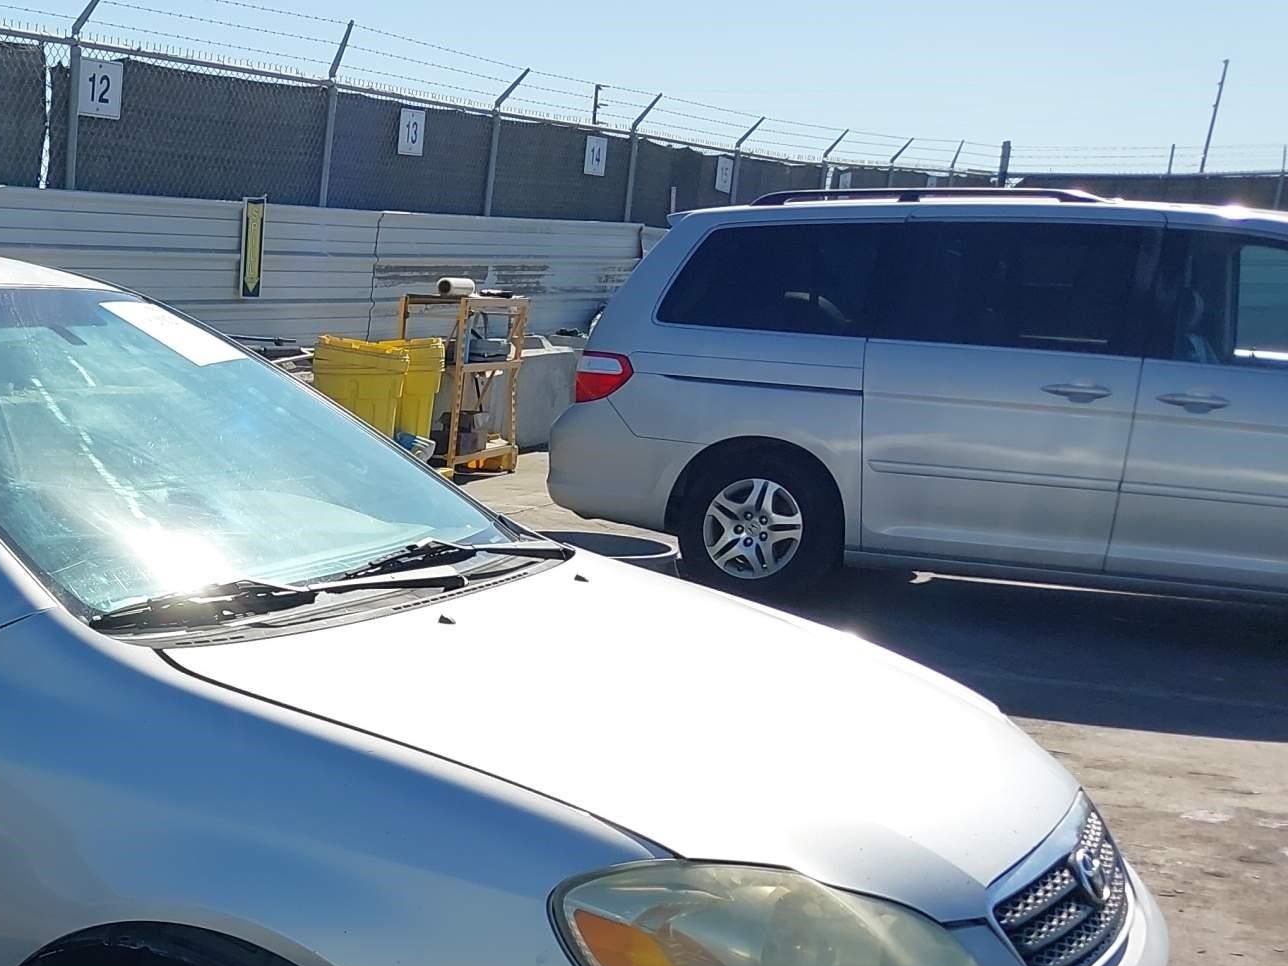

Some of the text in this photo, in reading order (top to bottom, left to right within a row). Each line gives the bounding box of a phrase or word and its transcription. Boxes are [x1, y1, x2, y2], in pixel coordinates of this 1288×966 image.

[89, 73, 110, 104] 12
[406, 121, 418, 145] 13
[591, 146, 601, 166] 14
